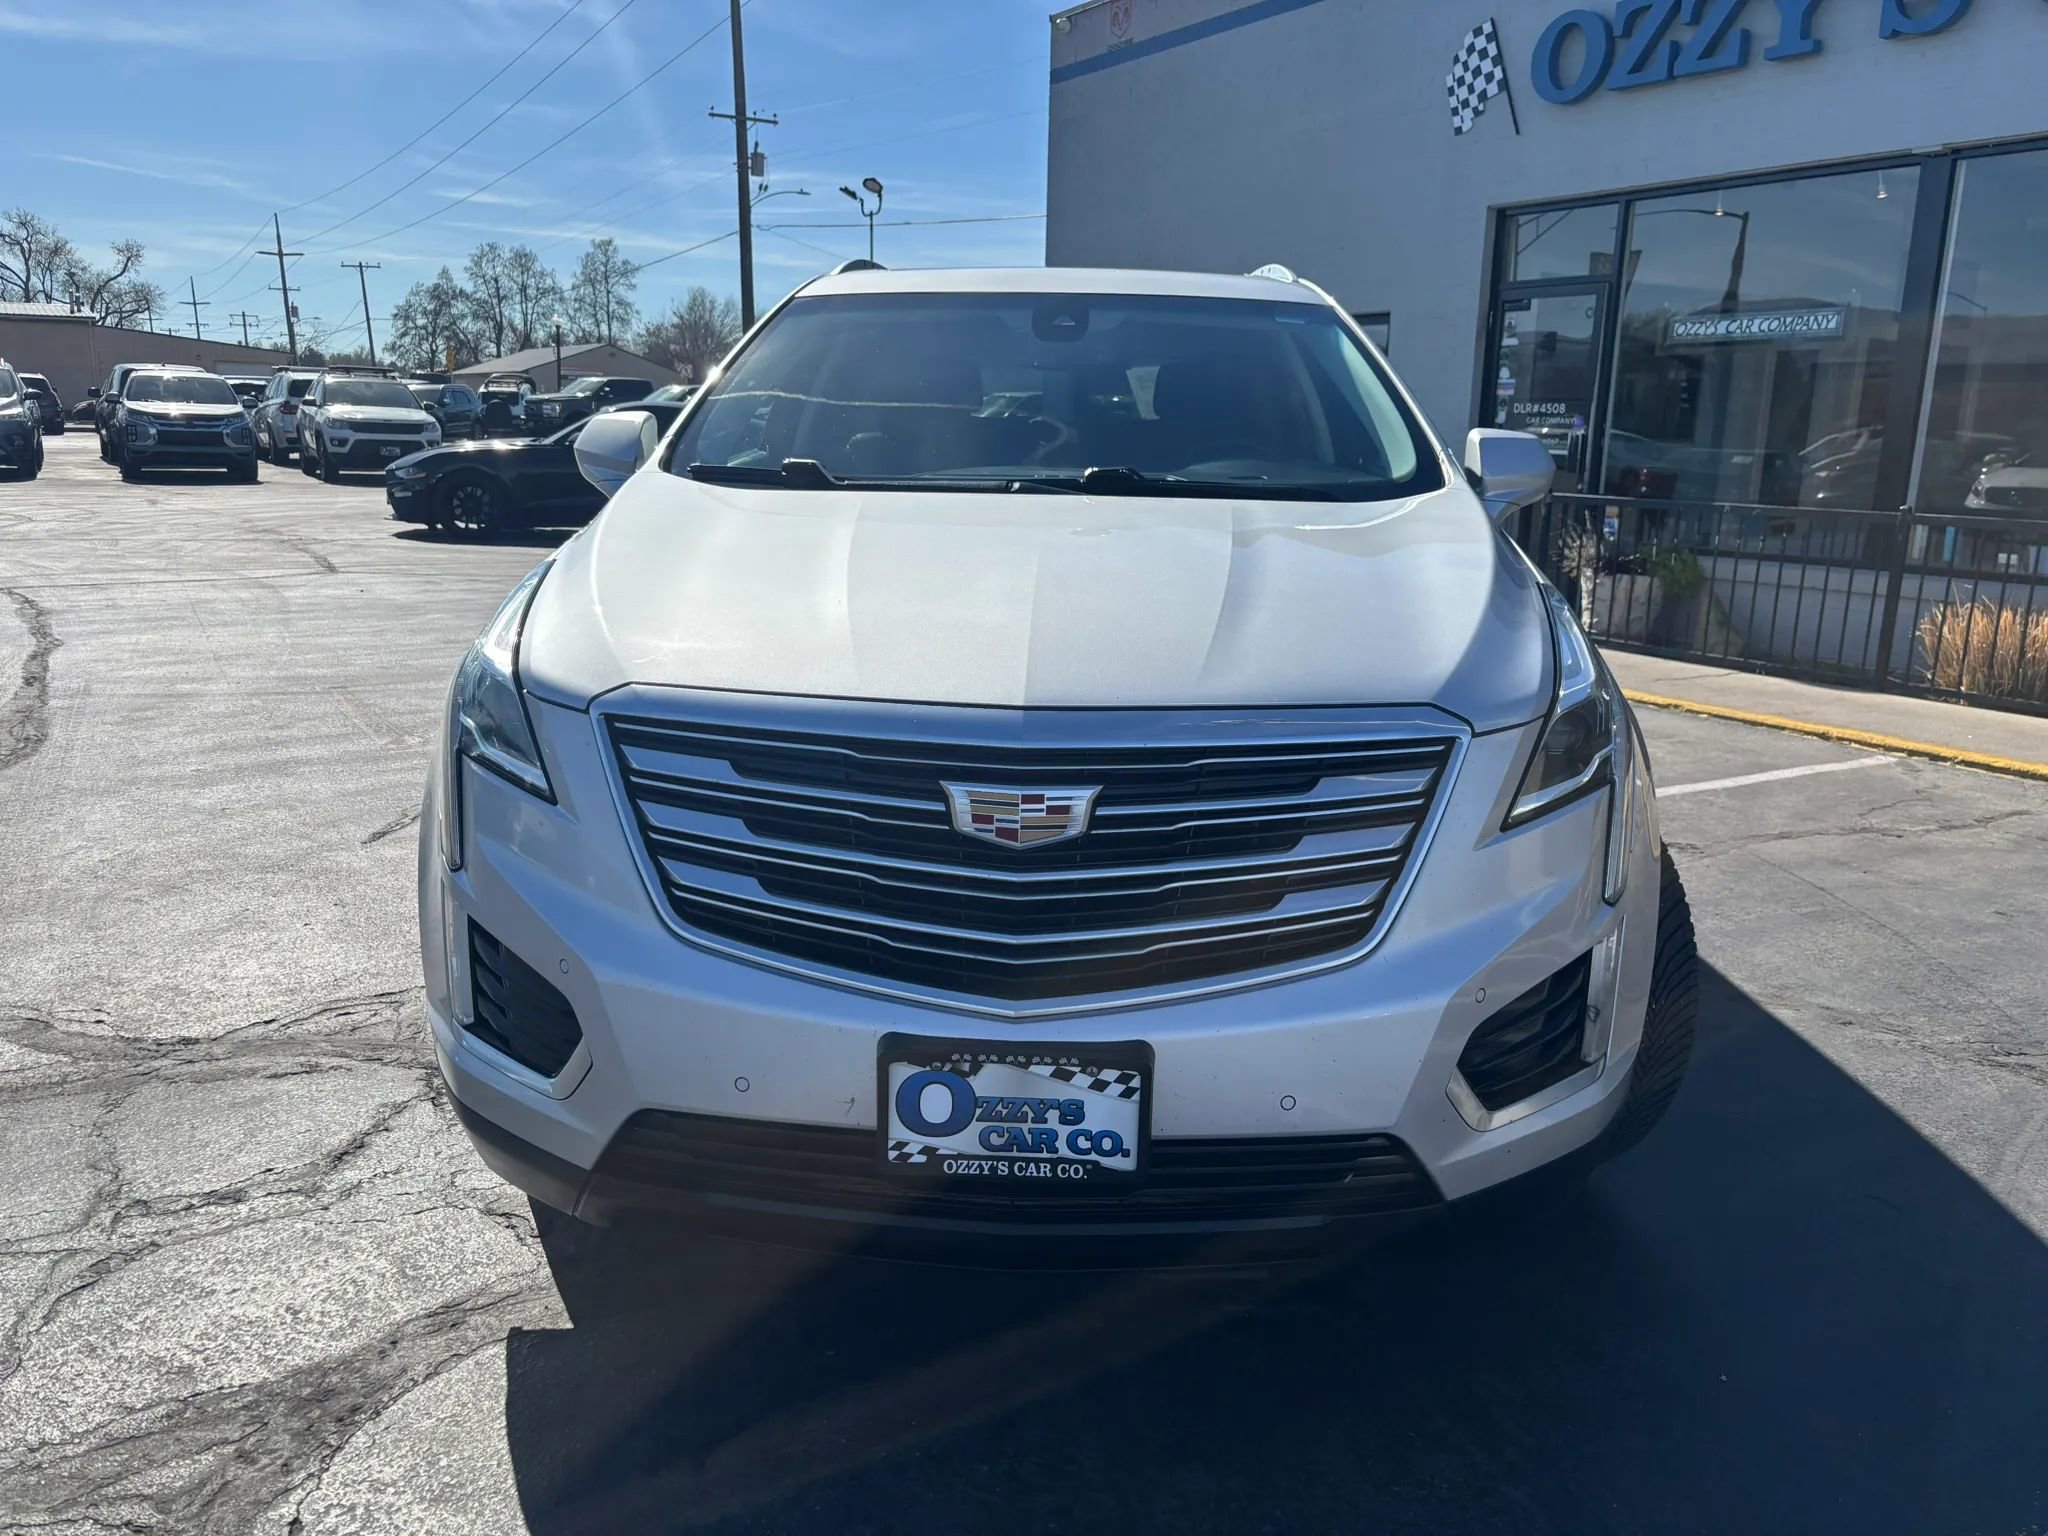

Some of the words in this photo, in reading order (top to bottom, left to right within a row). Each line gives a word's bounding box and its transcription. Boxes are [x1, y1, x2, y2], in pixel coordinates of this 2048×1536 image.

[1726, 318, 1754, 334] CAR
[1758, 314, 1835, 333] COMPANY
[1513, 403, 1566, 414] DLR#4508
[895, 1069, 1086, 1137] OZZY'S
[978, 1125, 1059, 1154] CAR
[1065, 1128, 1131, 1158] CO.
[943, 1159, 1009, 1175] OZZY'S
[1013, 1162, 1053, 1178] CAR
[1057, 1164, 1088, 1179] CO.
